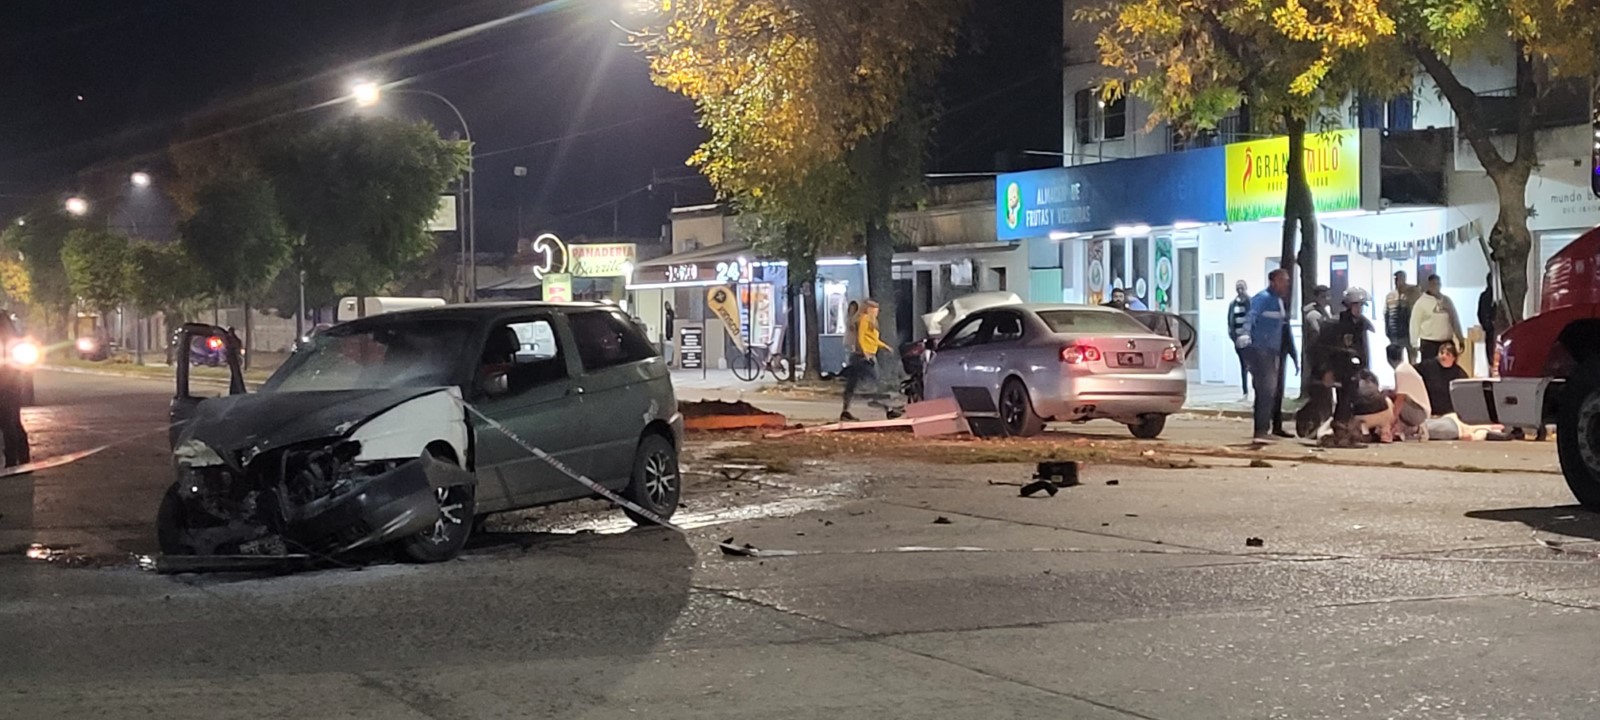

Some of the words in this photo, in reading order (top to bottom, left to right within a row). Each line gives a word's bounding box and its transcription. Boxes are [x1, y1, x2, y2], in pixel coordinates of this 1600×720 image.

[1306, 146, 1339, 174] MILO
[1550, 189, 1583, 203] mundo
[1025, 208, 1050, 228] FRUTAS
[571, 245, 635, 258] PANADERIA
[716, 261, 741, 281] 24
